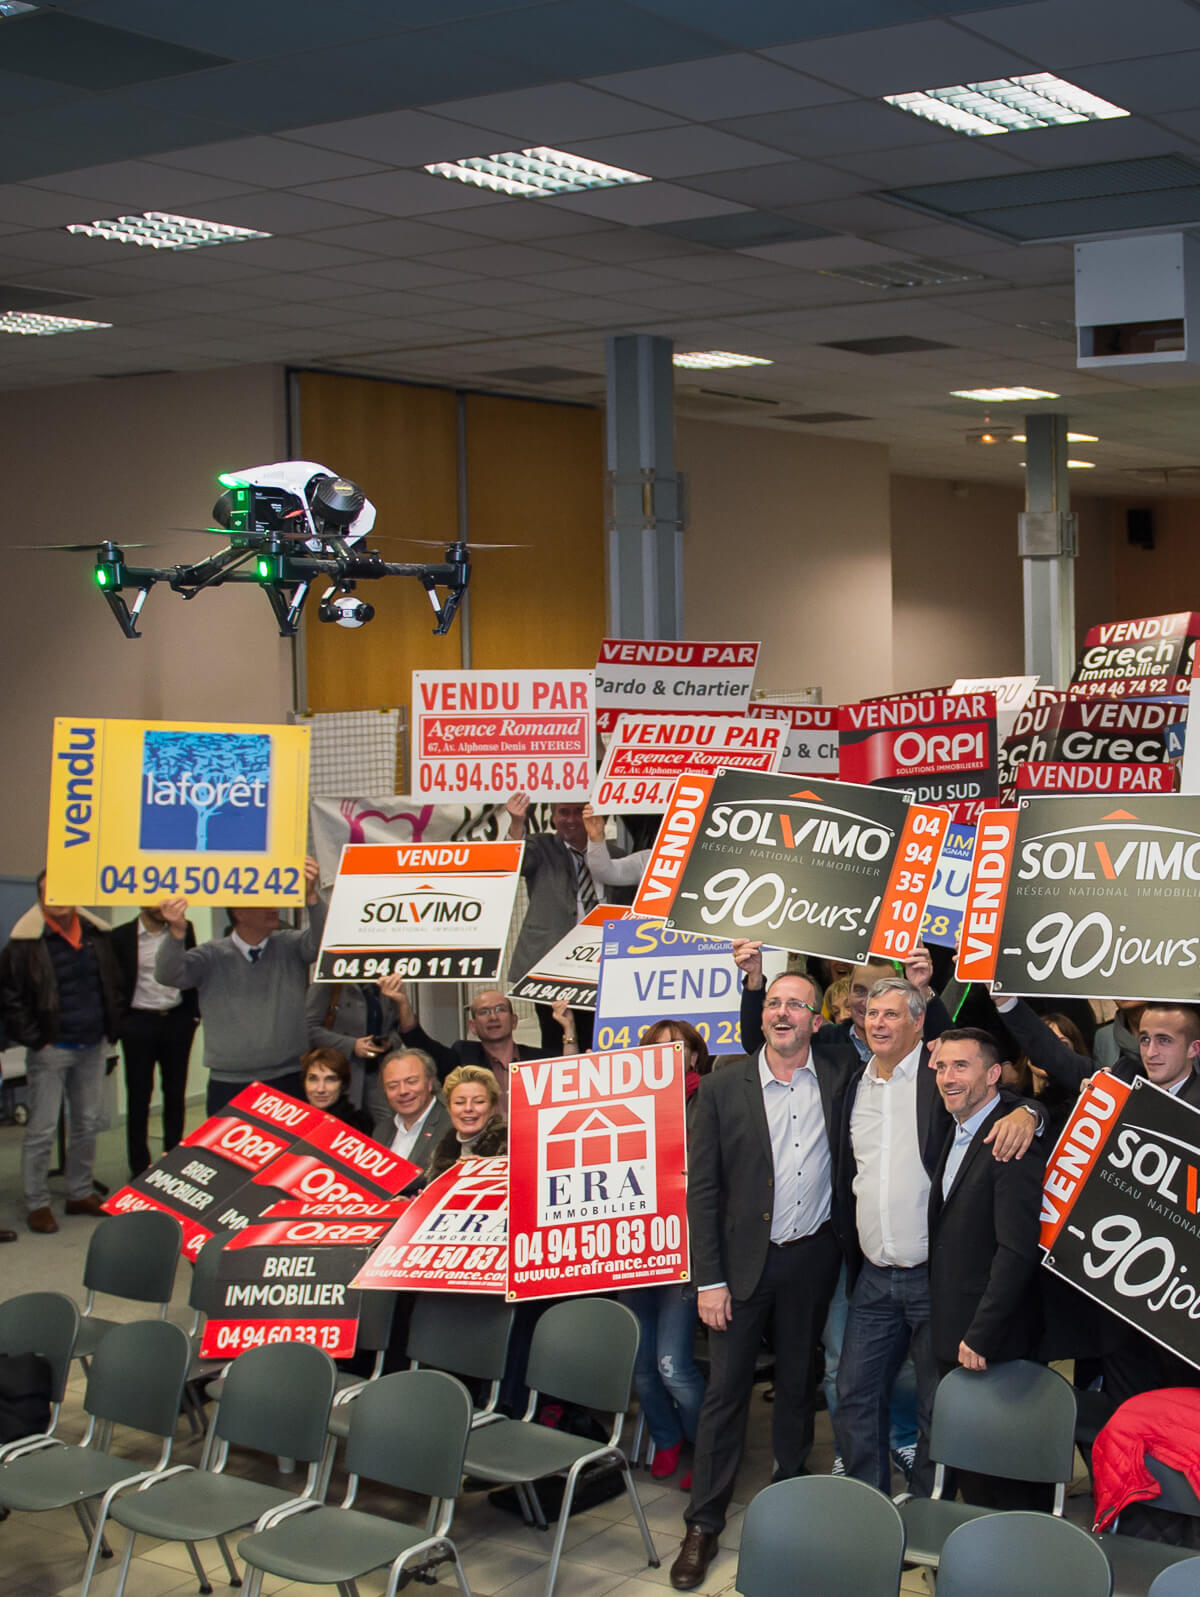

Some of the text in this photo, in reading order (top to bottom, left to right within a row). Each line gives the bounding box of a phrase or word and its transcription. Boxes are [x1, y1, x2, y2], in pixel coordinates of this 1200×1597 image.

[1100, 617, 1178, 643] VENDU
[602, 644, 755, 664] VENDU PAR
[1083, 640, 1174, 668] Grech
[1079, 662, 1169, 682] immobilier
[420, 681, 588, 710] VENDU PAR
[673, 679, 750, 697] Chartier
[1088, 680, 1147, 695] 94 74
[849, 700, 935, 729] VENDU
[943, 696, 987, 720] PAR
[427, 719, 580, 741] Agence Romand
[621, 724, 781, 748] VENDU PAR
[458, 740, 582, 754] Alphonse Denis HYERES
[893, 731, 984, 766] ORPI
[618, 751, 768, 768] Agence Romand
[896, 761, 984, 775] SOLUTIONS IMMOBILIERES
[58, 727, 96, 848] vendu
[419, 761, 590, 793] 04.94.65.84.84
[1028, 765, 1111, 789] VENDU
[1119, 766, 1163, 790] PAR
[146, 772, 266, 808] laforêt
[951, 783, 981, 798] SUD
[705, 805, 892, 862] SOLVIMO
[912, 814, 940, 837] 04
[642, 786, 704, 901] VENDU
[904, 843, 932, 865] 94
[396, 849, 470, 866] VENDU
[701, 841, 880, 877] RÉSEAU NATIONAL IMMOBILIER
[100, 865, 300, 895] 04 94 50 42 42
[895, 871, 926, 893] 35
[1016, 884, 1061, 896] RÉSEAU
[1068, 886, 1129, 897] NATIONAL
[964, 825, 1010, 965] VENDU
[360, 901, 482, 923] SOLVIMO
[891, 900, 917, 923] 10
[883, 930, 910, 952] 10
[333, 957, 483, 978] 04 94 60 11 11
[519, 983, 538, 996] 04
[520, 1047, 674, 1106] VENDU
[250, 1092, 309, 1127] VENDU
[221, 1124, 282, 1165] ORPI
[329, 1131, 398, 1177] VENDU
[1040, 1087, 1116, 1225] VENDU
[180, 1160, 218, 1185] BRIEL
[145, 1169, 214, 1211] IMMOBILIER
[546, 1166, 645, 1208] ERA
[300, 1203, 390, 1215] VENDU
[545, 1201, 647, 1221] IMMOBILIER
[514, 1214, 680, 1268] 04 94 50 83 00
[262, 1256, 317, 1277] BRIEL
[514, 1253, 682, 1284] www.erafrance.com
[225, 1284, 345, 1306] IMMOBILIER
[217, 1326, 341, 1348] 04 13
